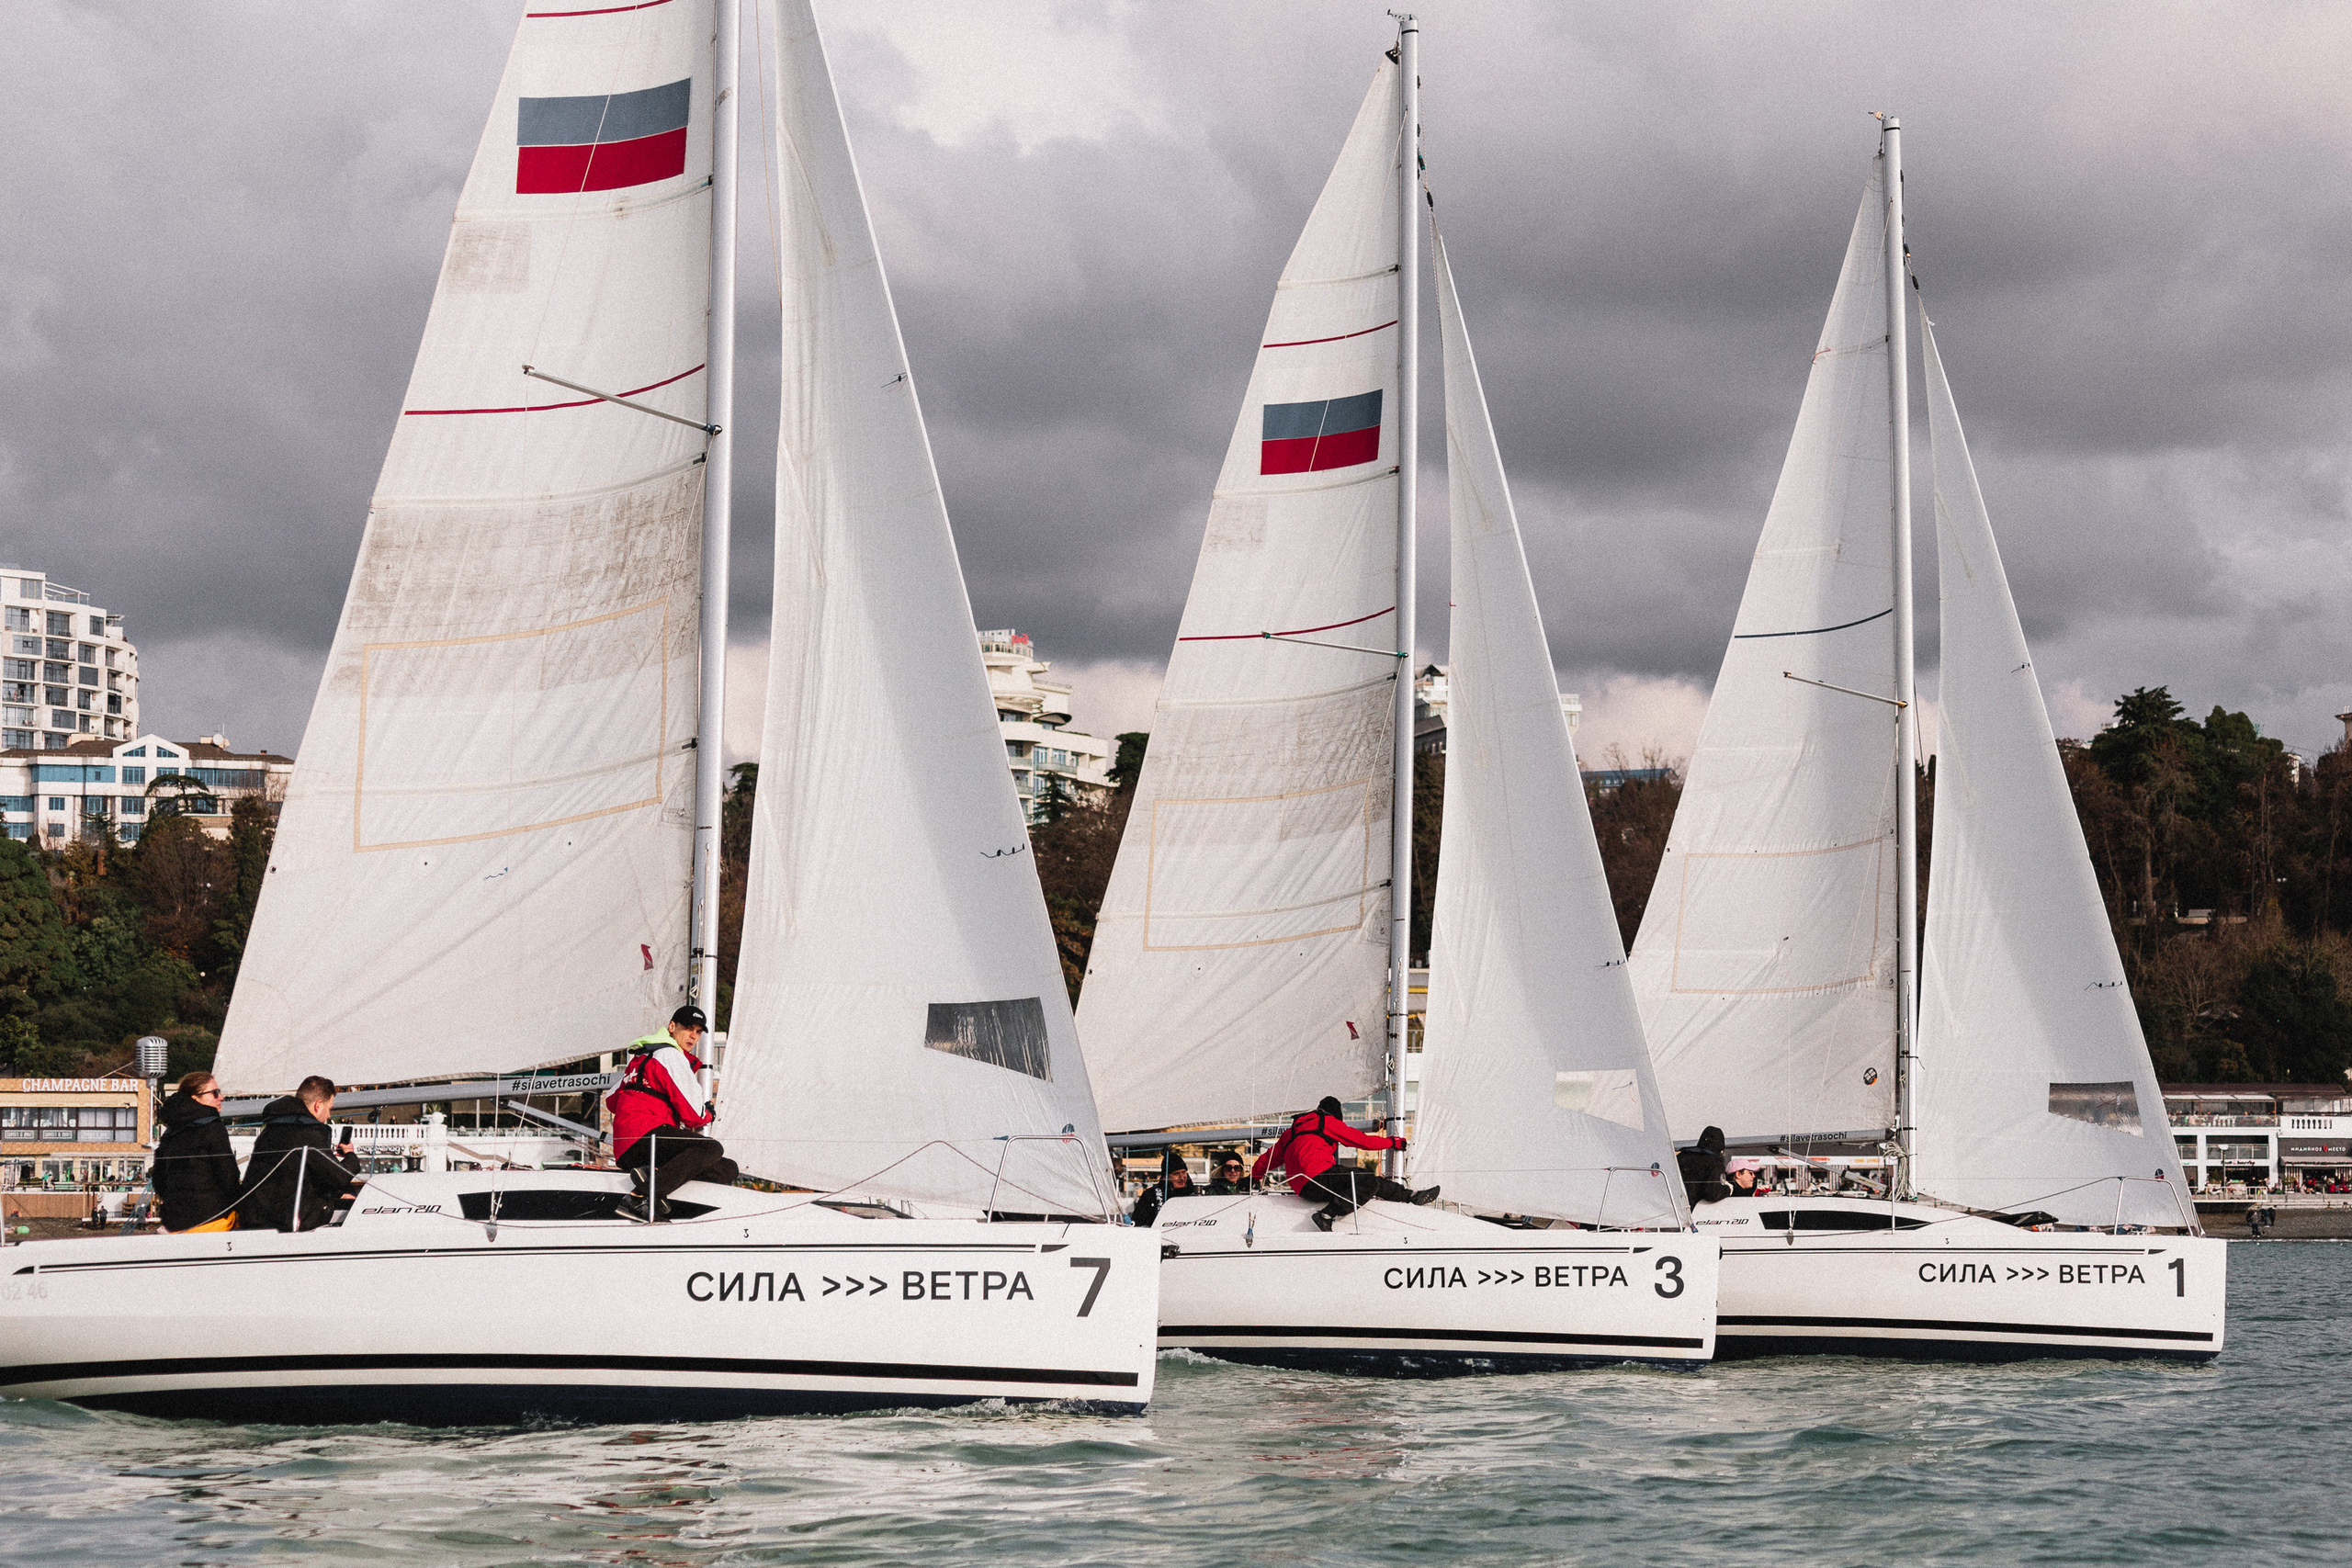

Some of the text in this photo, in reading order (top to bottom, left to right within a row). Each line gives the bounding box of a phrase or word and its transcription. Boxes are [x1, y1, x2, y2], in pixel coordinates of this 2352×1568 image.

[22, 1077, 139, 1092] CHAMPAGNE BAR
[512, 1072, 612, 1091] #silavetrasochi
[1780, 1131, 1848, 1143] #silavetrasochi
[1730, 1217, 1749, 1225] 210
[1384, 1267, 1467, 1290] СИЛА
[1534, 1266, 1629, 1287] ВЕТРА
[1654, 1256, 1685, 1299] 3
[1918, 1262, 1996, 1283] СИЛА
[2059, 1264, 2145, 1284] ВЕТРА
[2168, 1258, 2186, 1298] 1
[686, 1271, 806, 1302] СИЛА
[902, 1270, 1035, 1301] ВЕТРА
[1069, 1257, 1111, 1317] 7
